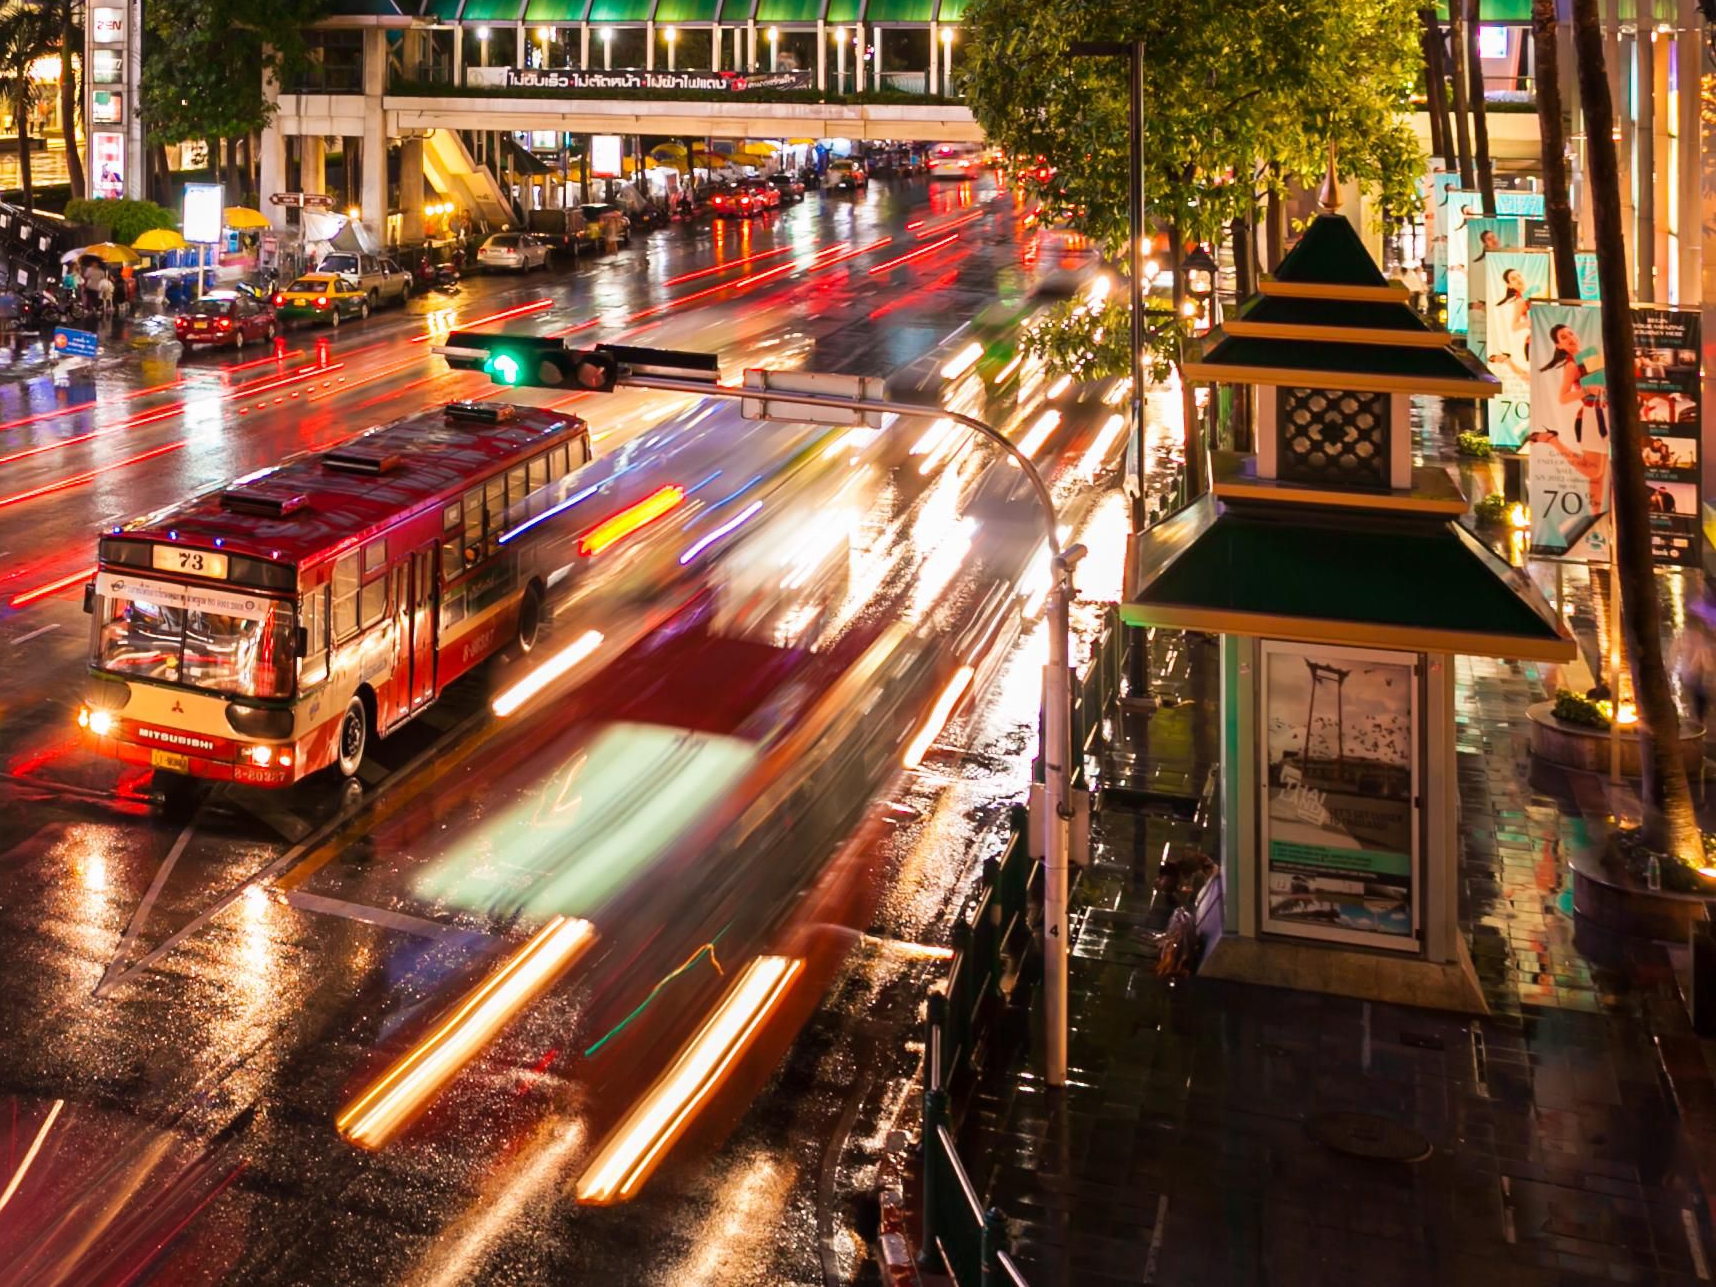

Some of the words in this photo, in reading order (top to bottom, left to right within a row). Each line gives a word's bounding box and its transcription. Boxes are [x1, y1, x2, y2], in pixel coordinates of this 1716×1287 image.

[1501, 400, 1530, 424] 70
[1543, 490, 1583, 518] 70
[179, 552, 204, 571] 73
[139, 728, 213, 750] MITSUBISHI
[1050, 924, 1059, 938] 4
